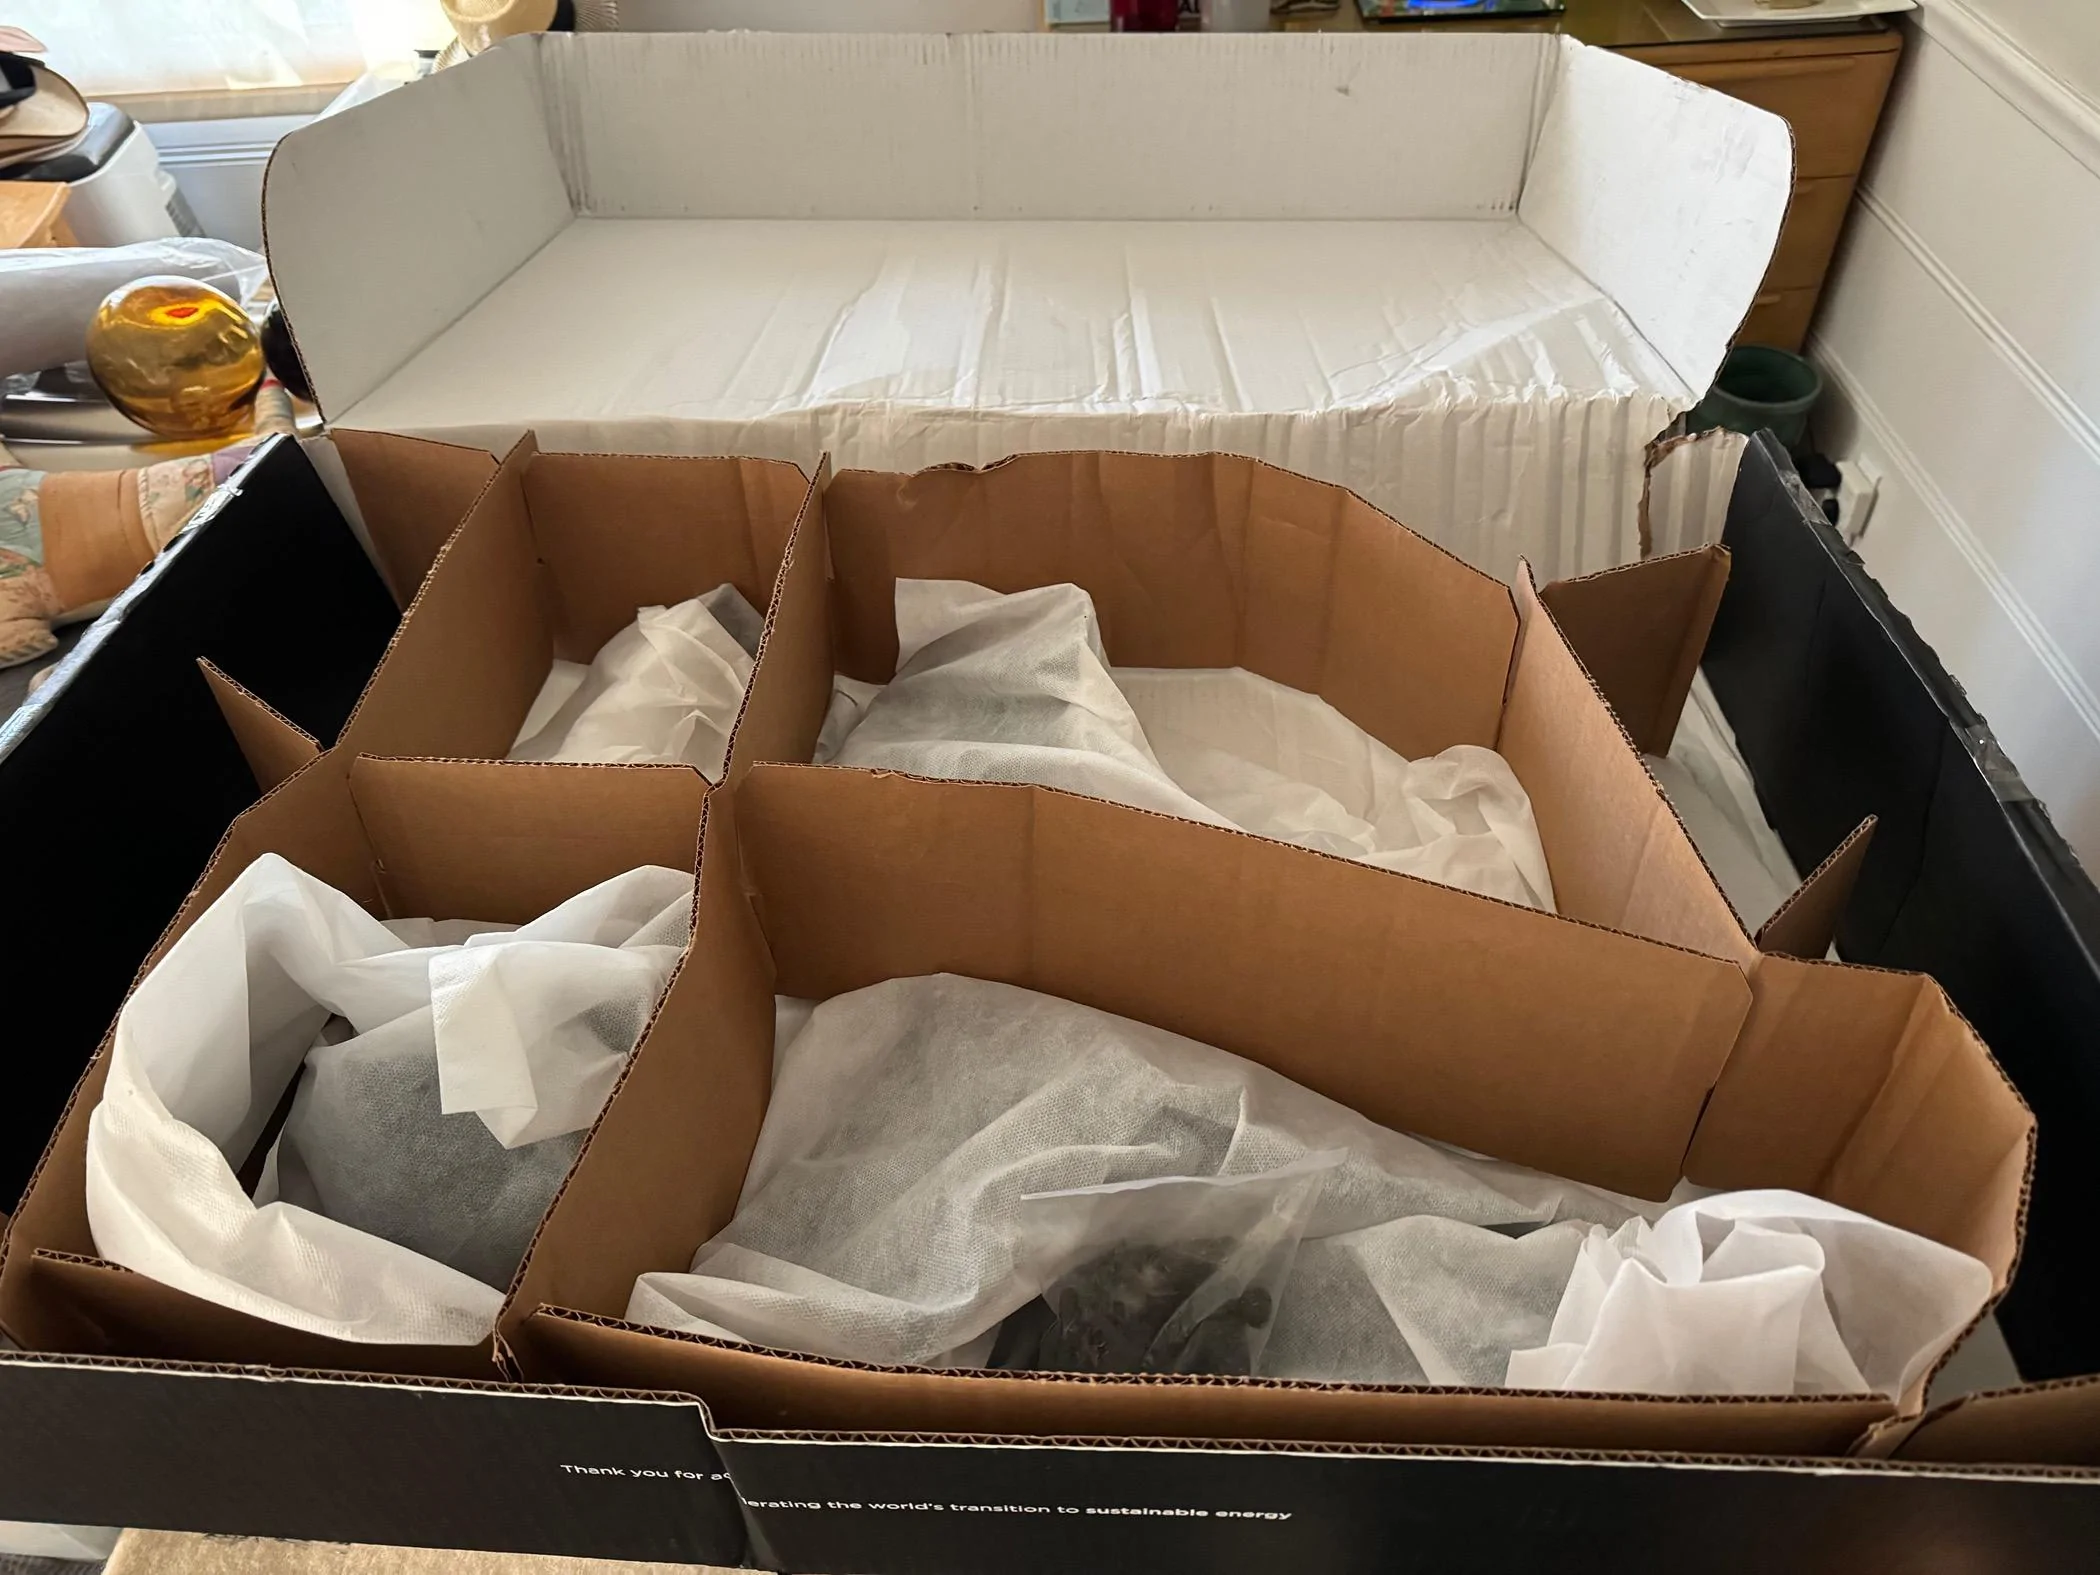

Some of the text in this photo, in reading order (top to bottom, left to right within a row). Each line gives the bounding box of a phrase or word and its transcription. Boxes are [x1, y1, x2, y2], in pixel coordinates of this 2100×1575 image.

[559, 1464, 626, 1476] Thank
[629, 1469, 669, 1478] you
[673, 1470, 704, 1480] for
[826, 1501, 862, 1509] the
[867, 1502, 945, 1511] world's
[949, 1503, 1051, 1513] transition
[1056, 1506, 1080, 1514] to
[1085, 1507, 1209, 1517] sustainable
[1215, 1510, 1292, 1521] energy
